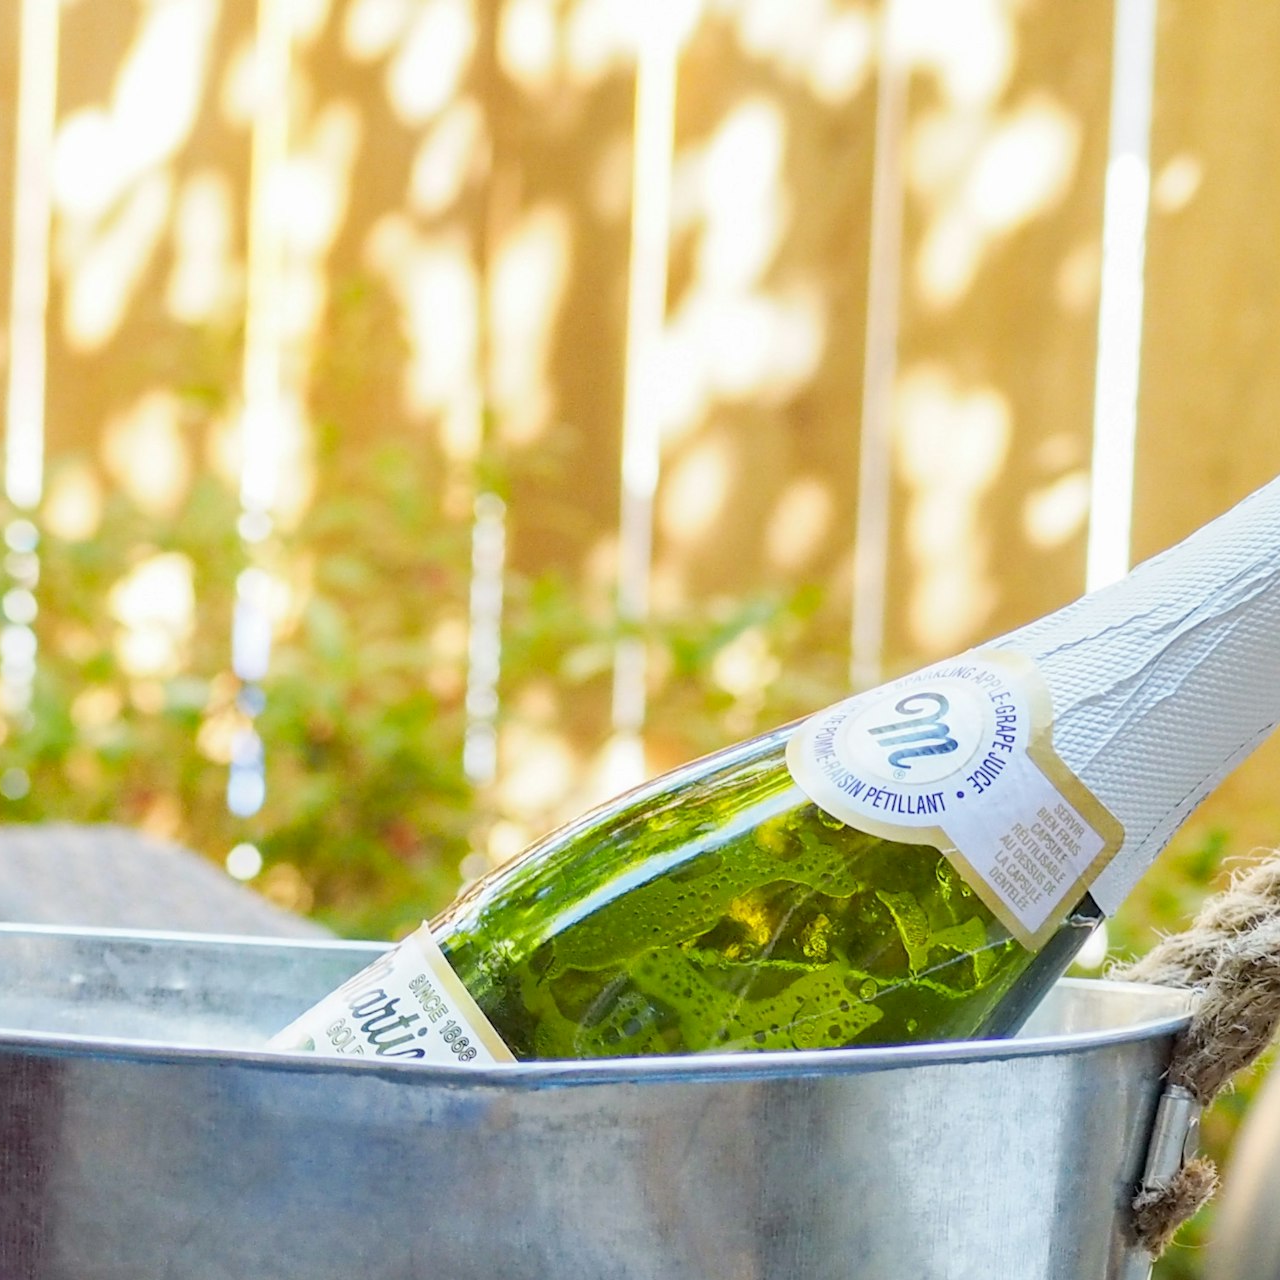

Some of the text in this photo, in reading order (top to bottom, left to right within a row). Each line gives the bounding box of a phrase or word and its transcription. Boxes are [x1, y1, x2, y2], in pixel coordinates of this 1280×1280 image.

[970, 670, 1017, 754] APPLE-GRAPE
[813, 725, 866, 798] POMME-RAISIN
[862, 786, 946, 814] PÉTILLANT
[966, 751, 1007, 794] JUICE
[1030, 822, 1068, 864] CAPSULE
[1036, 806, 1082, 857] BIEN FRAIS
[1054, 803, 1085, 838] SERVIR
[994, 850, 1042, 904] LA CAPSULE
[999, 834, 1057, 897] AU DESSUS DE
[1011, 822, 1066, 884] RÉUTILISABLE
[989, 866, 1030, 912] DENTELÉE
[408, 973, 478, 1063] SINCE 1868
